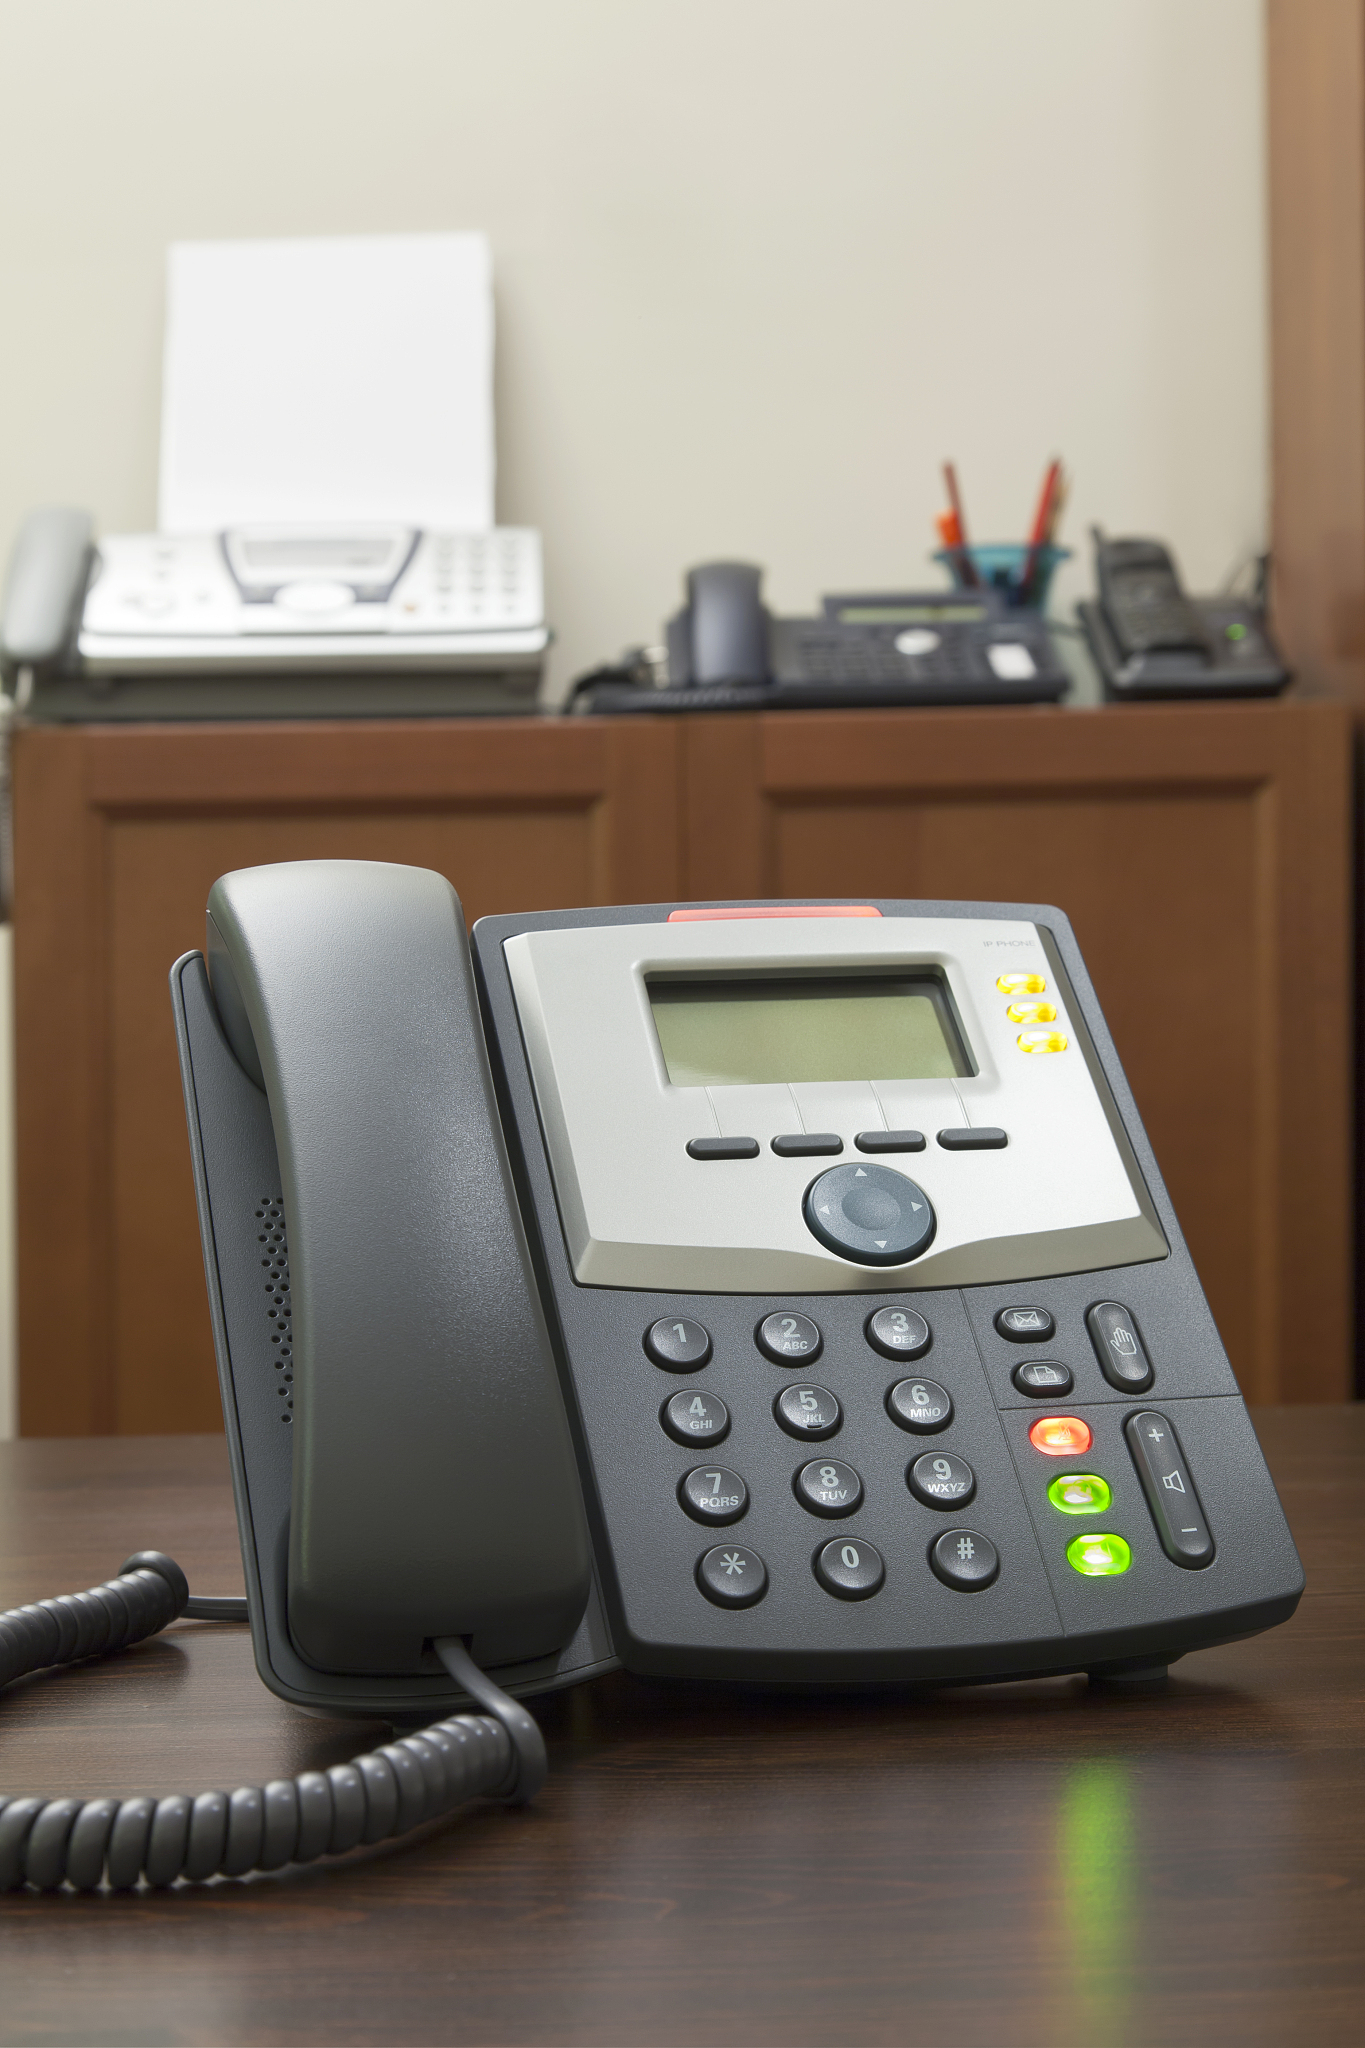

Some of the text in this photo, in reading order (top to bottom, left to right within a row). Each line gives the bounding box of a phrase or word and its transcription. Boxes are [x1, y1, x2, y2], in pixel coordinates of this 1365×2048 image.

[781, 1318, 800, 1338] 2
[890, 1313, 909, 1332] 3
[672, 1323, 687, 1343] 1
[892, 1335, 916, 1344] DEF
[782, 1340, 808, 1350] ABC
[799, 1391, 818, 1411] 5
[911, 1385, 930, 1405] 6
[690, 1396, 706, 1416] 4
[910, 1407, 941, 1418] MNO
[690, 1420, 712, 1430] GHI
[803, 1414, 825, 1423] JKL
[819, 1466, 839, 1488] 8
[932, 1459, 952, 1480] 9
[705, 1473, 722, 1494] 7
[927, 1482, 965, 1493] WXYZ
[700, 1496, 739, 1507] PQRS
[820, 1490, 848, 1501] TUV
[841, 1545, 859, 1568] 0
